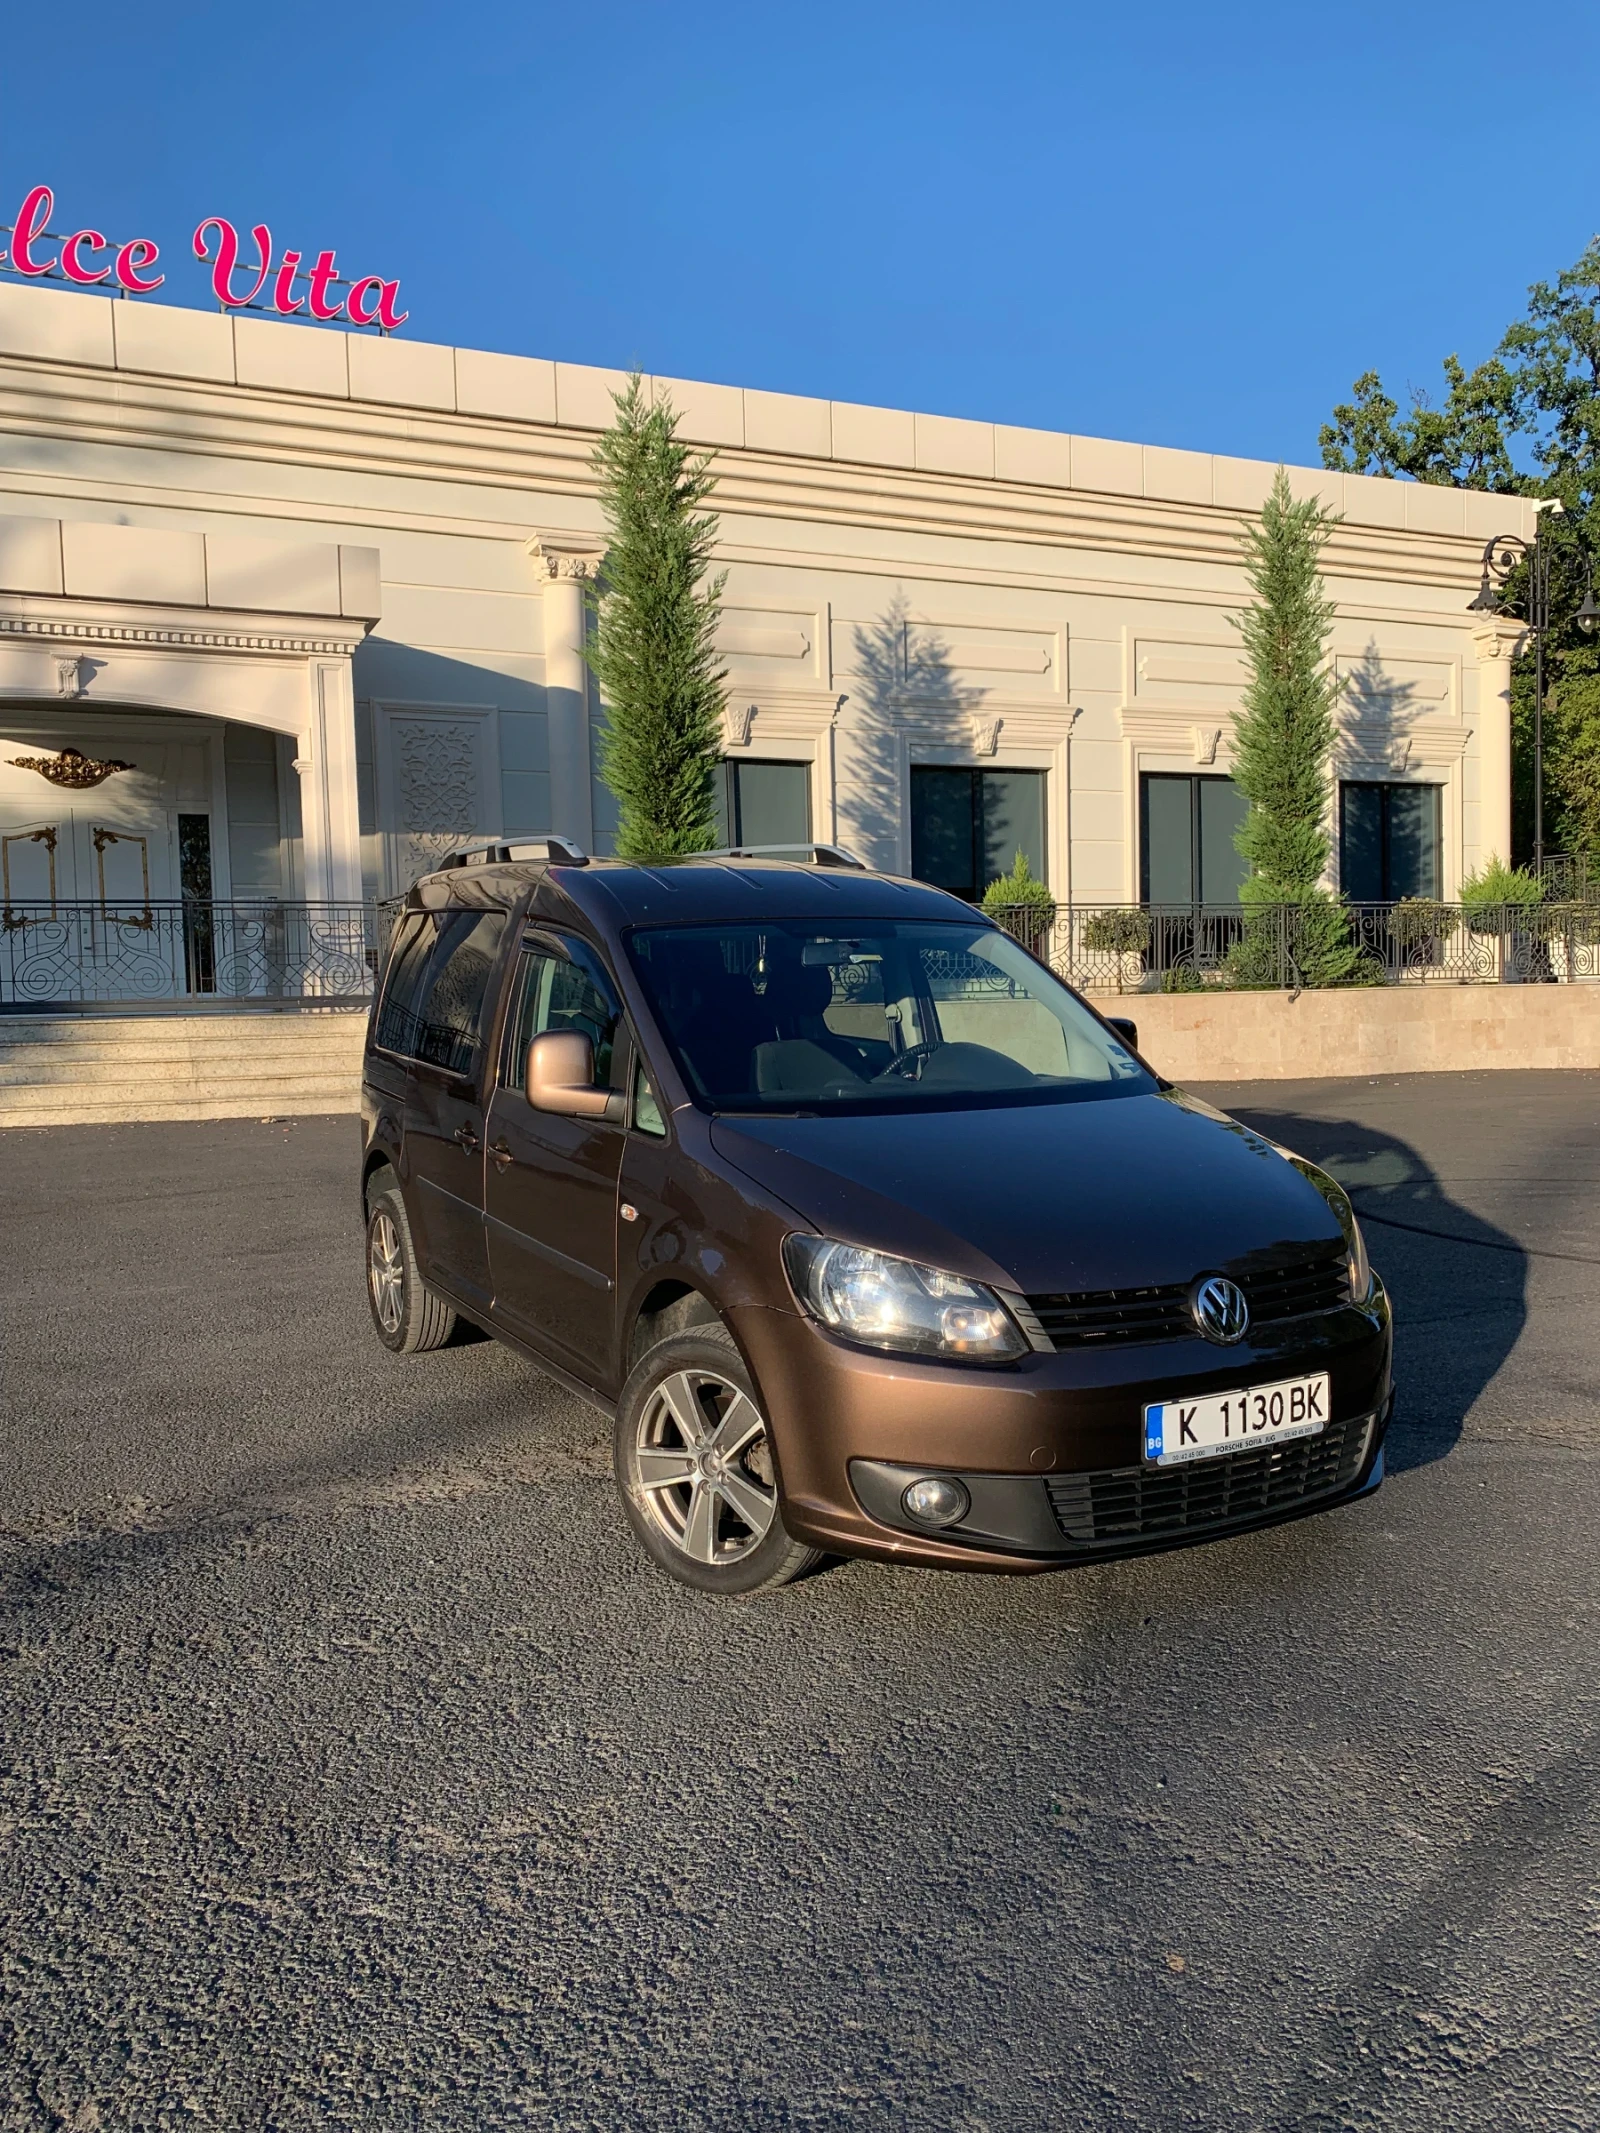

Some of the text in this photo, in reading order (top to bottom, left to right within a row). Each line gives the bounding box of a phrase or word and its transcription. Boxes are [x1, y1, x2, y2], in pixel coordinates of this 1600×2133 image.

[0, 185, 409, 330] lce Vita
[1179, 1381, 1324, 1446] K 1130 BK
[1148, 1436, 1162, 1450] BG
[1215, 1442, 1243, 1453] PORSCHE
[1245, 1438, 1262, 1447] SOFIA
[1265, 1435, 1276, 1443] JUG
